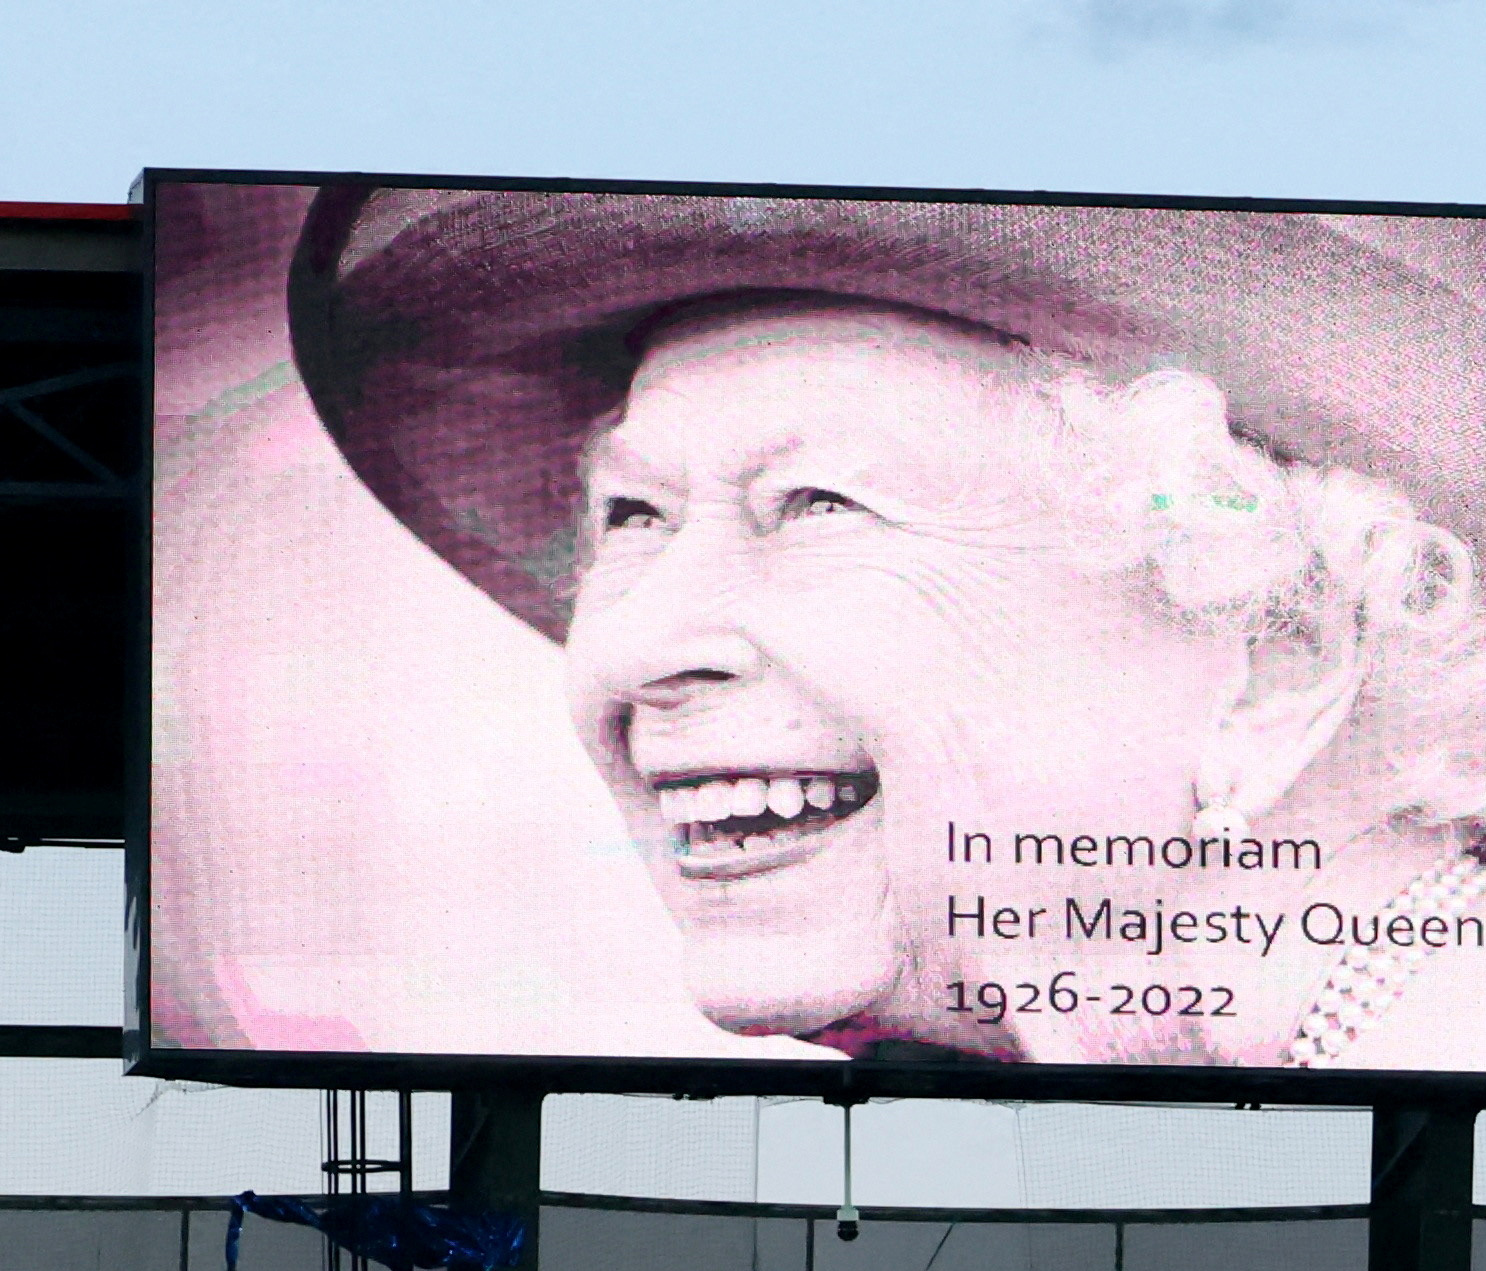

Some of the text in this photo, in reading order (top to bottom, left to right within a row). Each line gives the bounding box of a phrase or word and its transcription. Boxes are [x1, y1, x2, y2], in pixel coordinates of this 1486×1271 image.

[946, 820, 1323, 872] In memoriam
[946, 895, 1046, 940] Her
[1065, 896, 1283, 956] Majesty
[1302, 902, 1486, 952] Queen
[945, 972, 1238, 1025] 1926-2022
